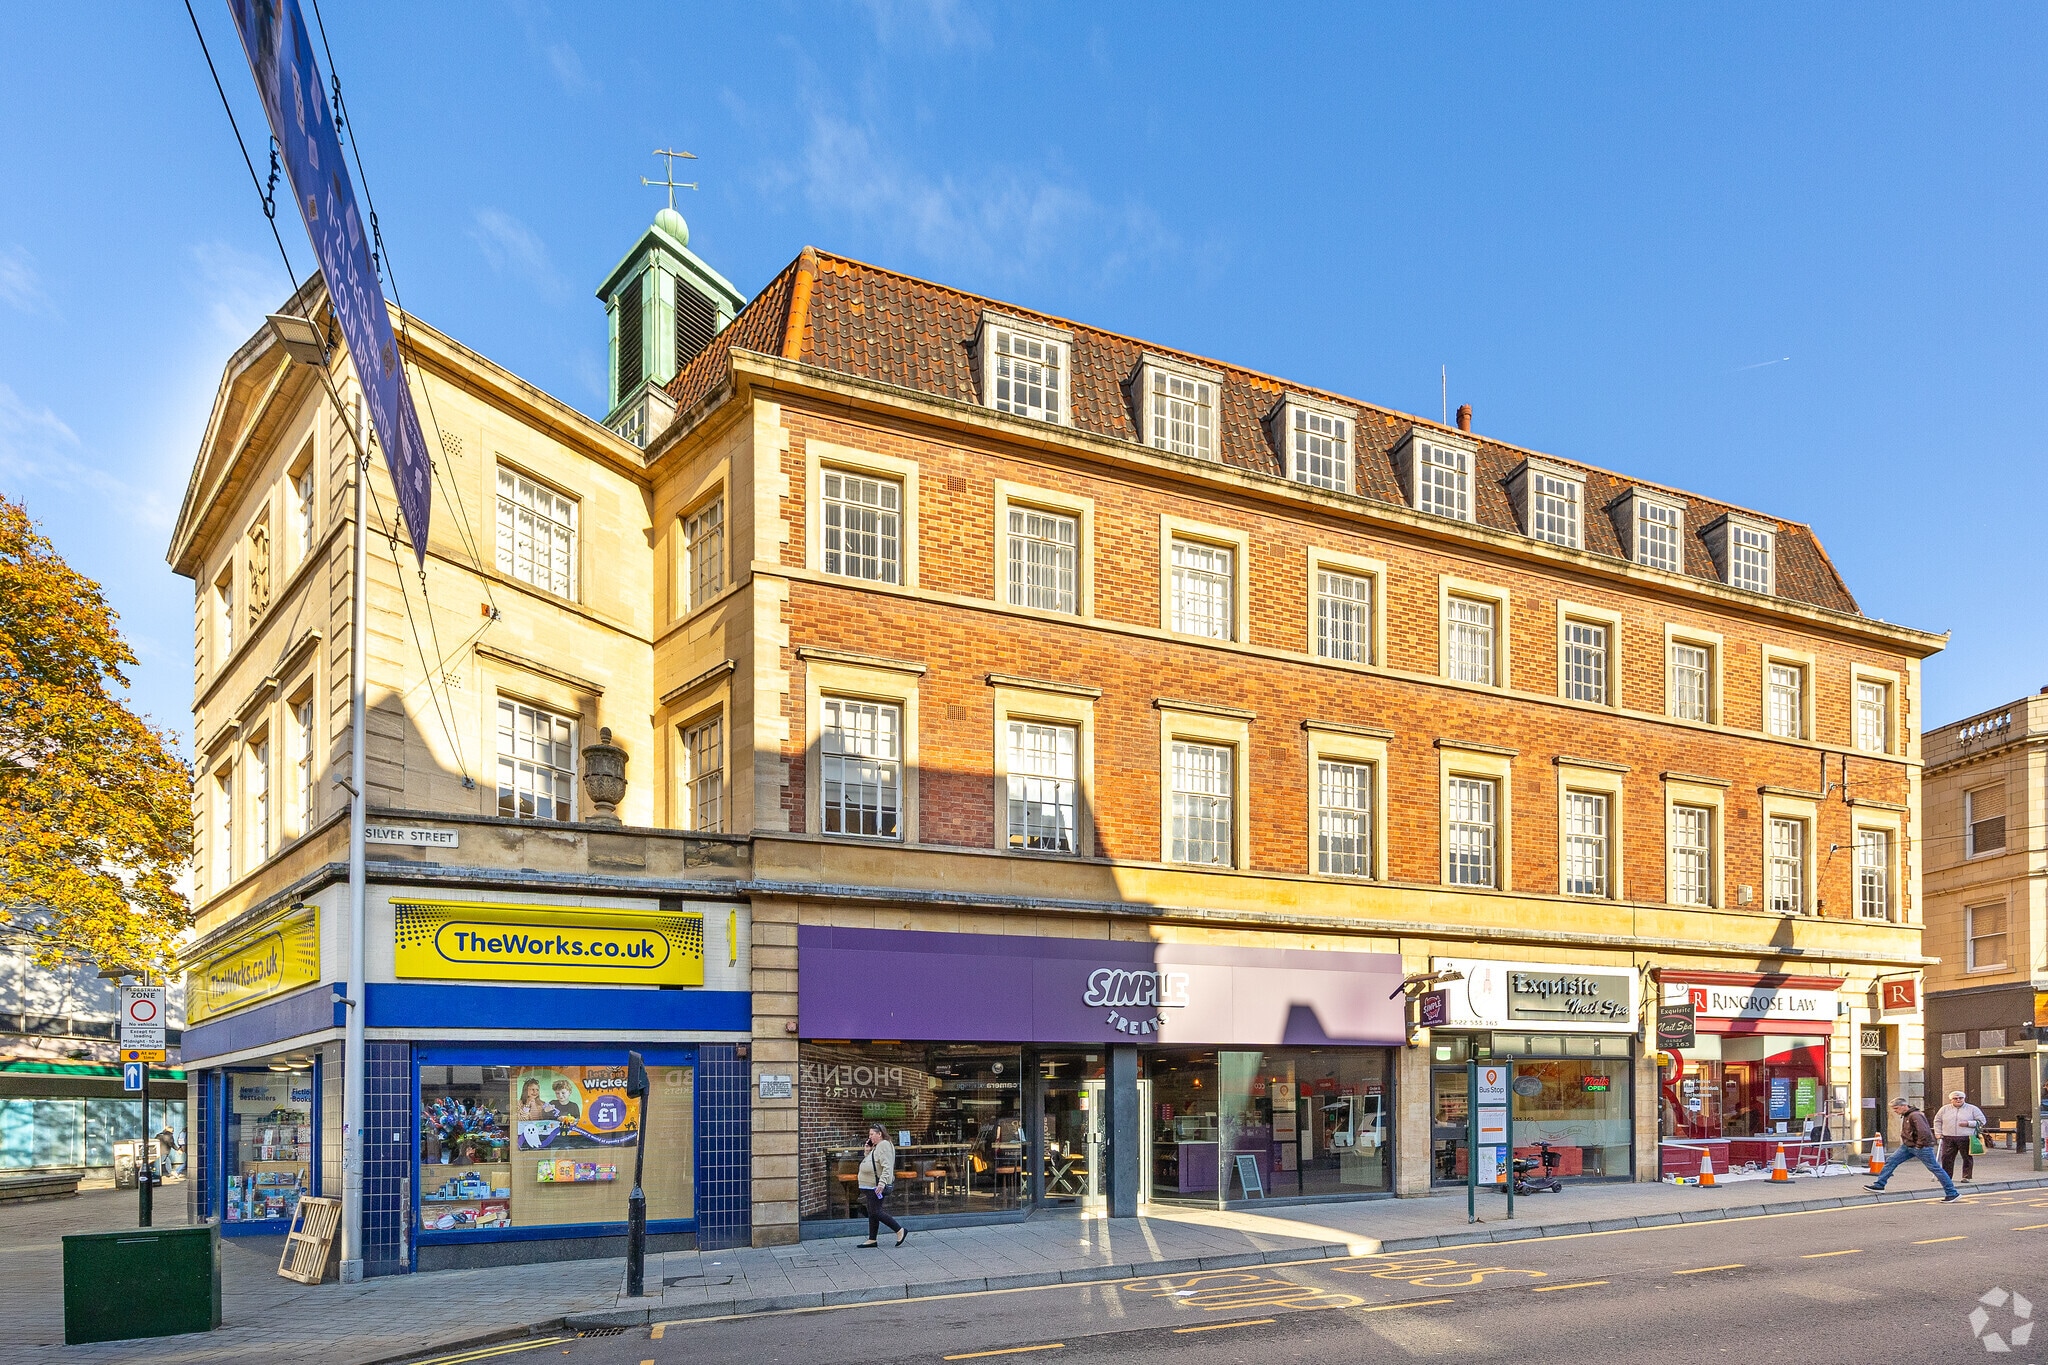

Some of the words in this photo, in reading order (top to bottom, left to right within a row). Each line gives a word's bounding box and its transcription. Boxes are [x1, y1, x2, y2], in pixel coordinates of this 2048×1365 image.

[347, 250, 380, 380] DECEMBER
[323, 230, 357, 343] LINCOLN
[355, 333, 372, 391] ARTS
[371, 383, 392, 453] CENTRE
[365, 828, 404, 840] SILVER
[411, 831, 453, 843] STREET
[454, 932, 655, 959] TheWorks.co.uk
[211, 946, 278, 999] TheWorks.co.uk
[1514, 973, 1600, 999] Exquisite
[1892, 985, 1913, 1003] R
[1423, 999, 1442, 1014] SIMPLE
[1565, 998, 1600, 1014] Nail
[1600, 999, 1630, 1018] Spa
[1692, 991, 1707, 1009] R
[1712, 992, 1784, 1012] RINGROSE
[1788, 996, 1817, 1011] LAW
[1660, 1006, 1691, 1015] Exquisite
[1105, 1010, 1170, 1035] TREATS
[1658, 1022, 1676, 1032] Nail
[1676, 1020, 1693, 1032] Spa
[1490, 1086, 1504, 1095] Stop
[1583, 1076, 1610, 1086] Nails
[240, 1094, 276, 1102] Bestsellers
[597, 1107, 618, 1123] £1
[1331, 1257, 1548, 1287] BUS
[1122, 1273, 1366, 1311] STOP
